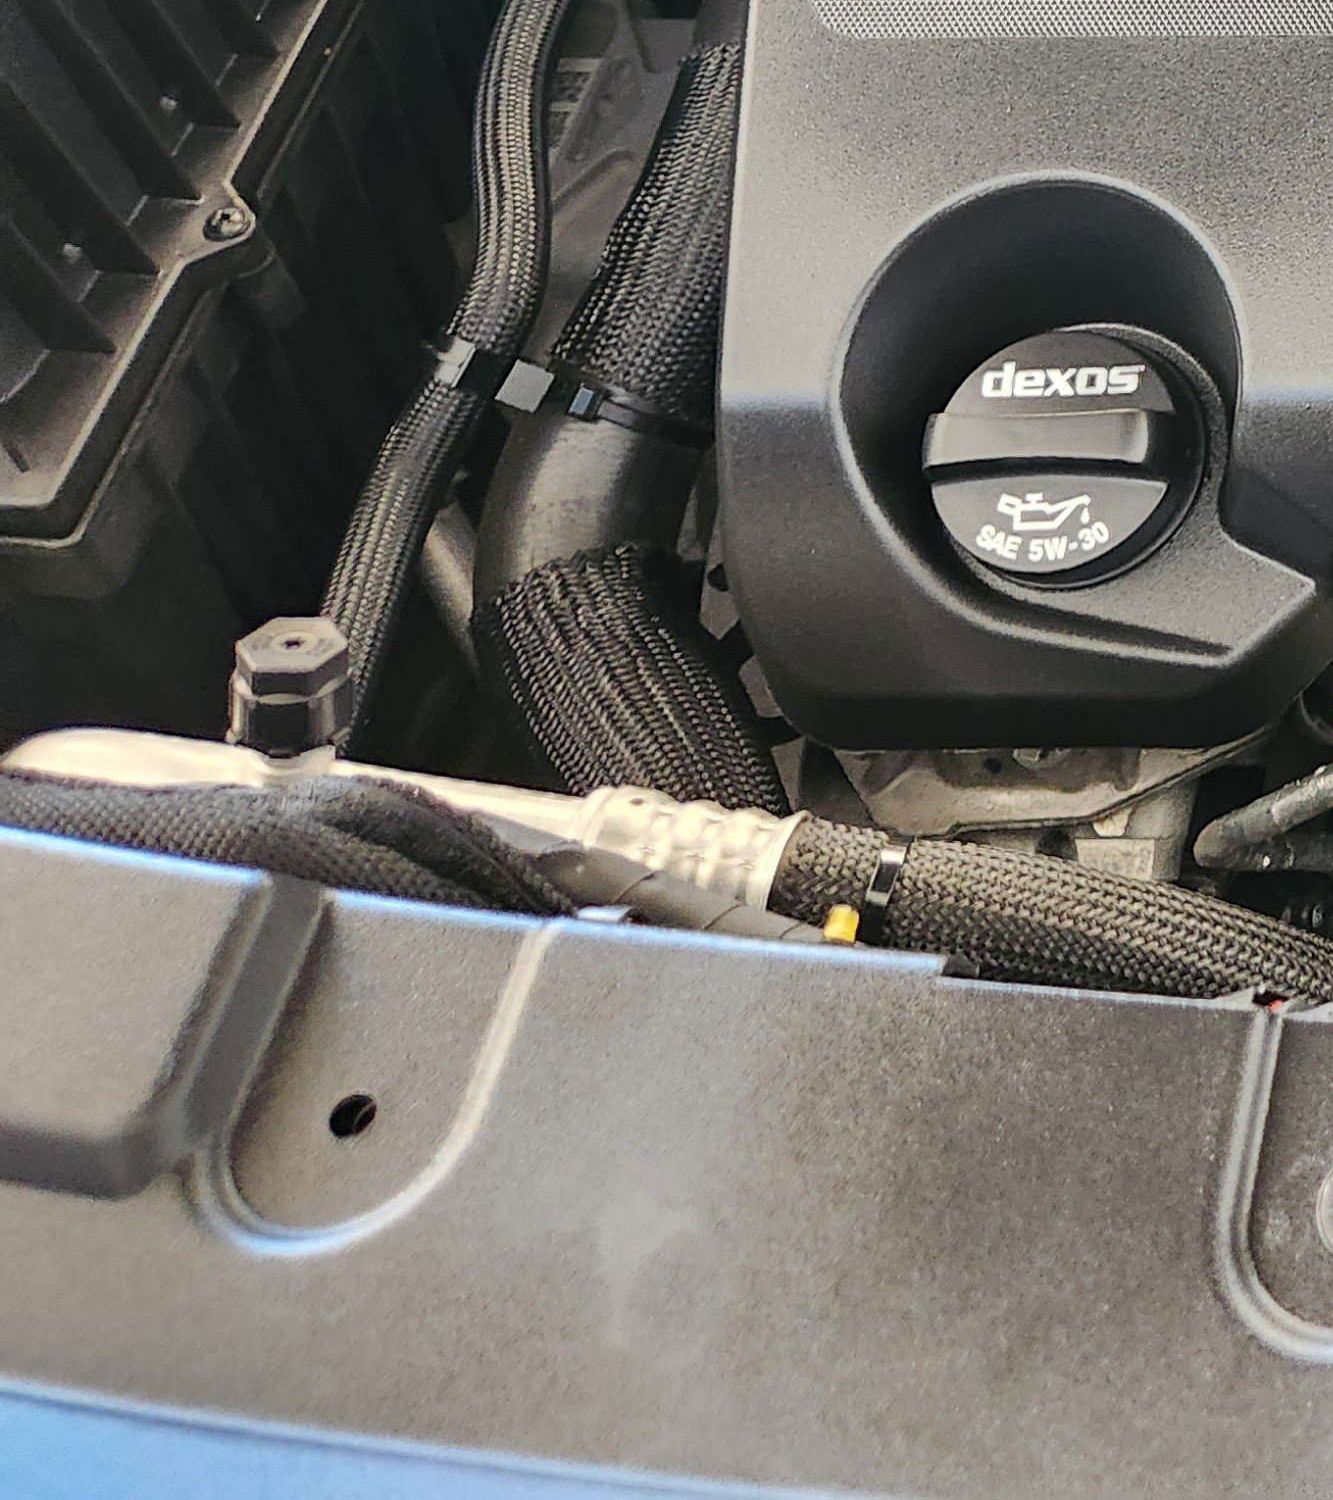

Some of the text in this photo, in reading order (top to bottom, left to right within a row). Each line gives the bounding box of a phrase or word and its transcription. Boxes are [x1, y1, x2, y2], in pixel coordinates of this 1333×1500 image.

[981, 360, 1146, 398] dexos
[975, 521, 1110, 562] SAE 5W-30
